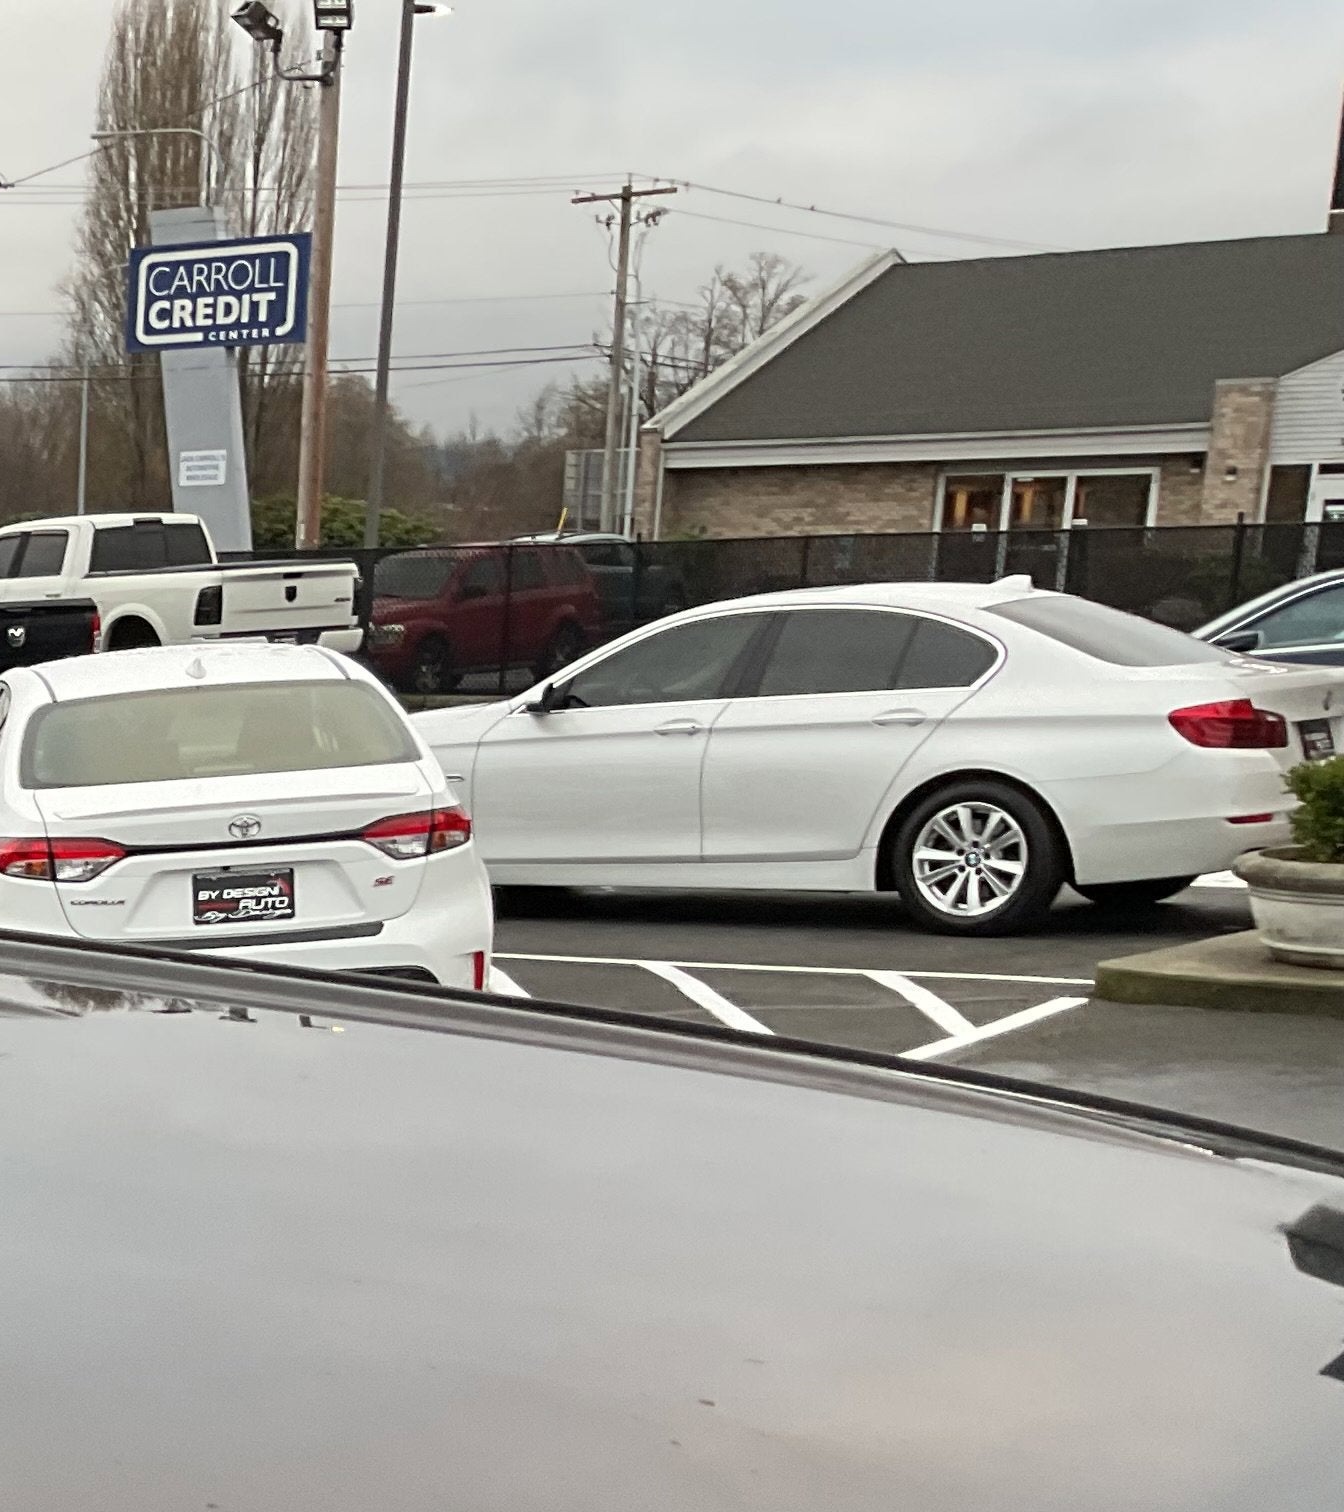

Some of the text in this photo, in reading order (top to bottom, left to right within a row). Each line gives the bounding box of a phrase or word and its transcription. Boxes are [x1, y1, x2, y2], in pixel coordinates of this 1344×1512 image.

[148, 257, 284, 297] CARROLL
[148, 291, 276, 330] CREDIT
[208, 328, 270, 341] CENTER
[197, 890, 220, 901] BY
[238, 896, 289, 910] AUTO
